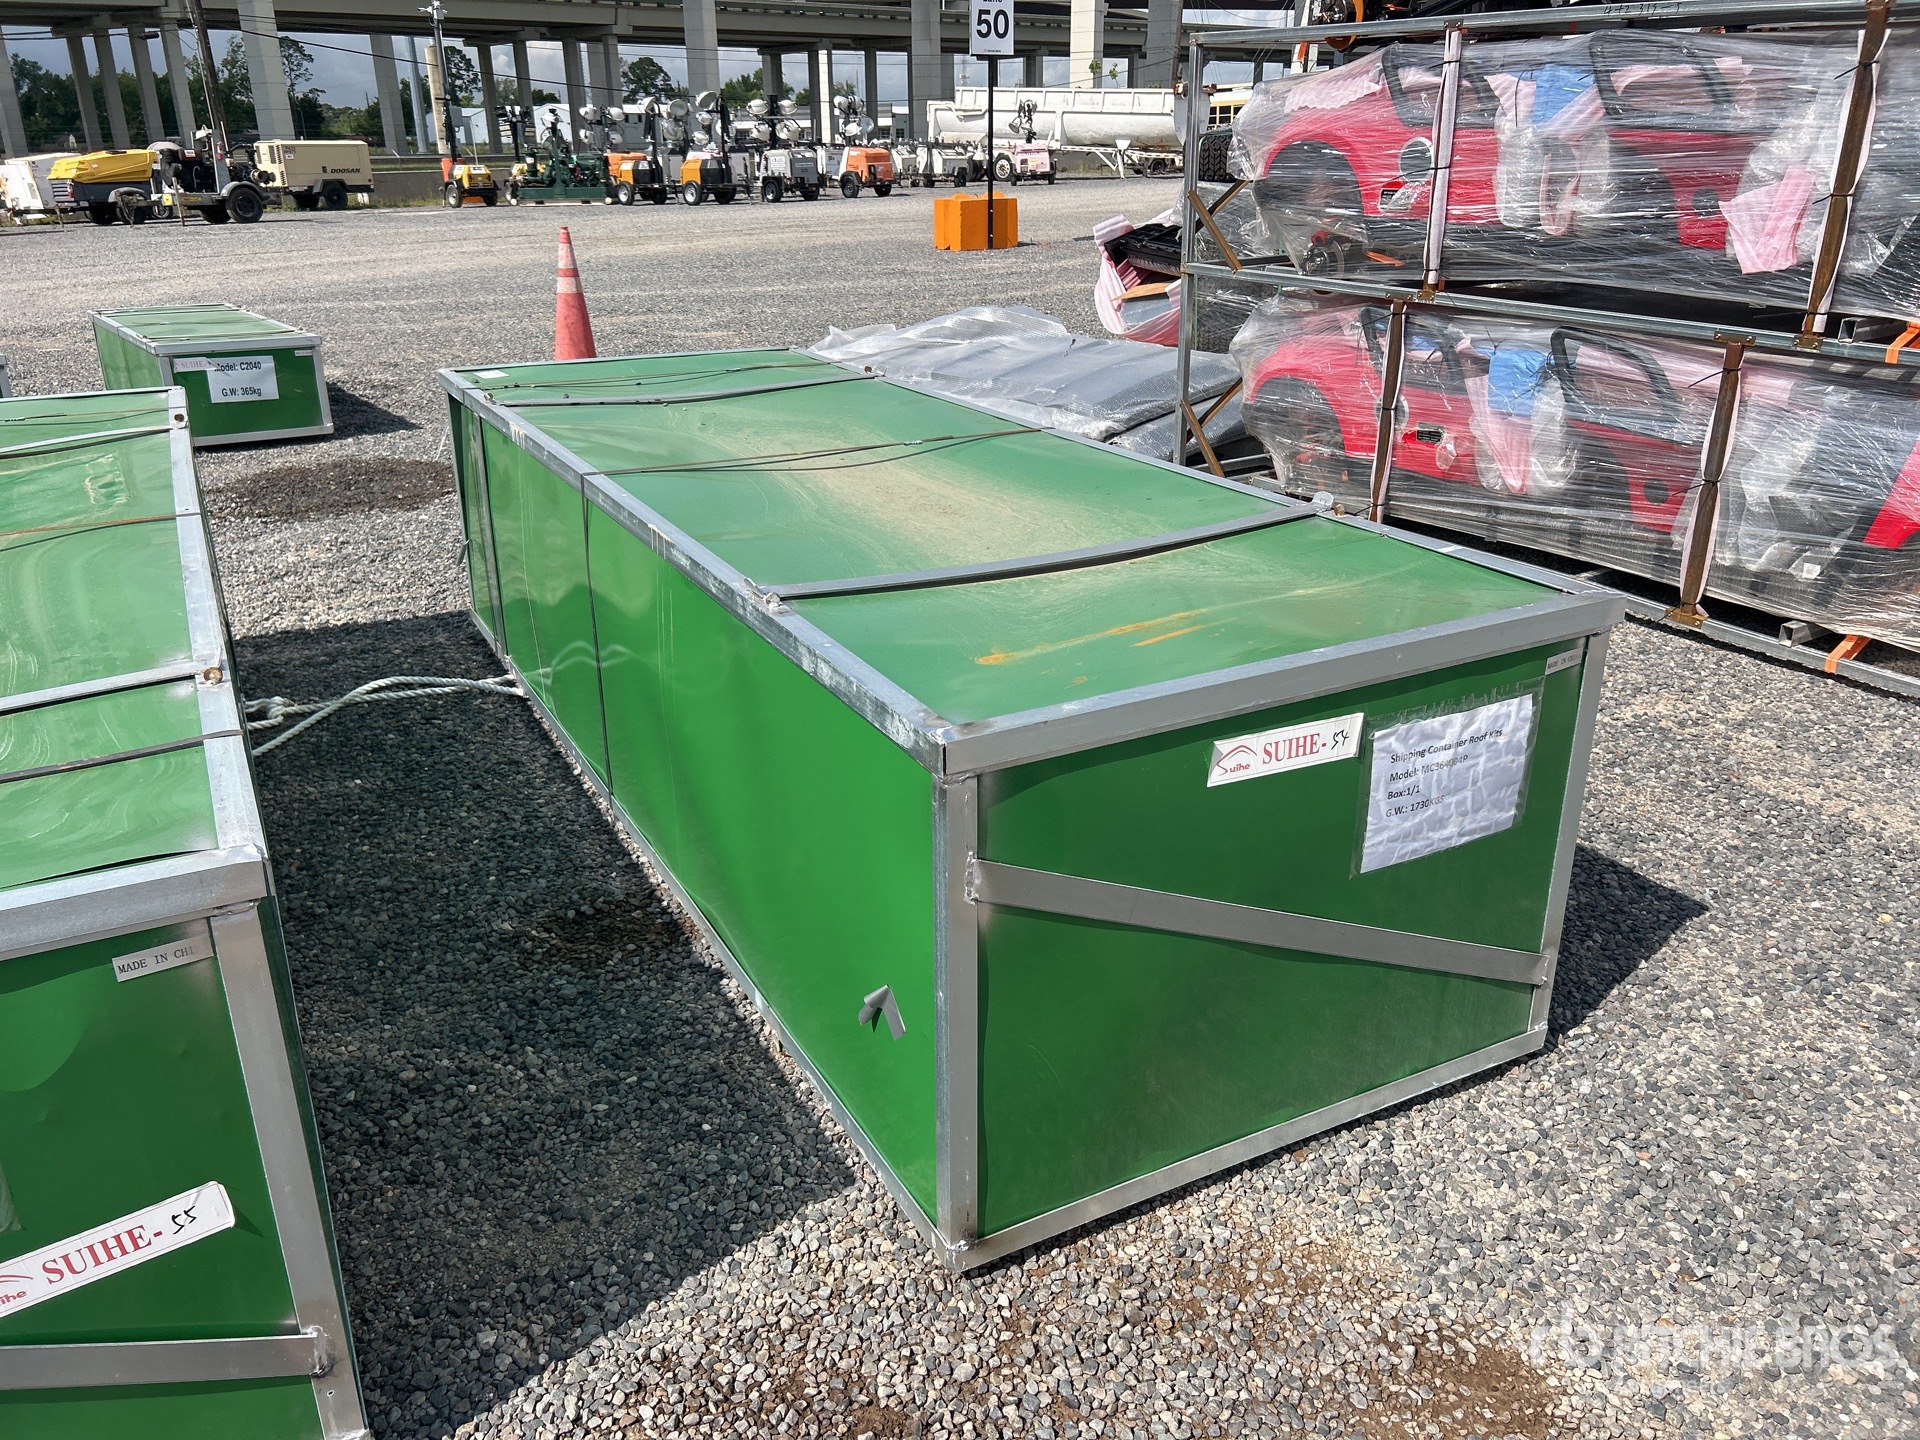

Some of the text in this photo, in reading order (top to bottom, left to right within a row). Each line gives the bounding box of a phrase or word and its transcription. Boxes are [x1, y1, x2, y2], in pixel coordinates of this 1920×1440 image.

[976, 9, 1009, 39] 50
[215, 361, 262, 372] odel: C2040
[222, 387, 262, 397] G.W: 365kg
[1390, 729, 1503, 763] Shipping Container Roof Kits
[1389, 768, 1419, 782] Model:
[1387, 785, 1420, 800] Box:1/1
[1385, 795, 1445, 818] G.W.: 1730KGS
[117, 959, 148, 974] MADE
[154, 952, 168, 965] IN
[171, 1205, 197, 1235] 55
